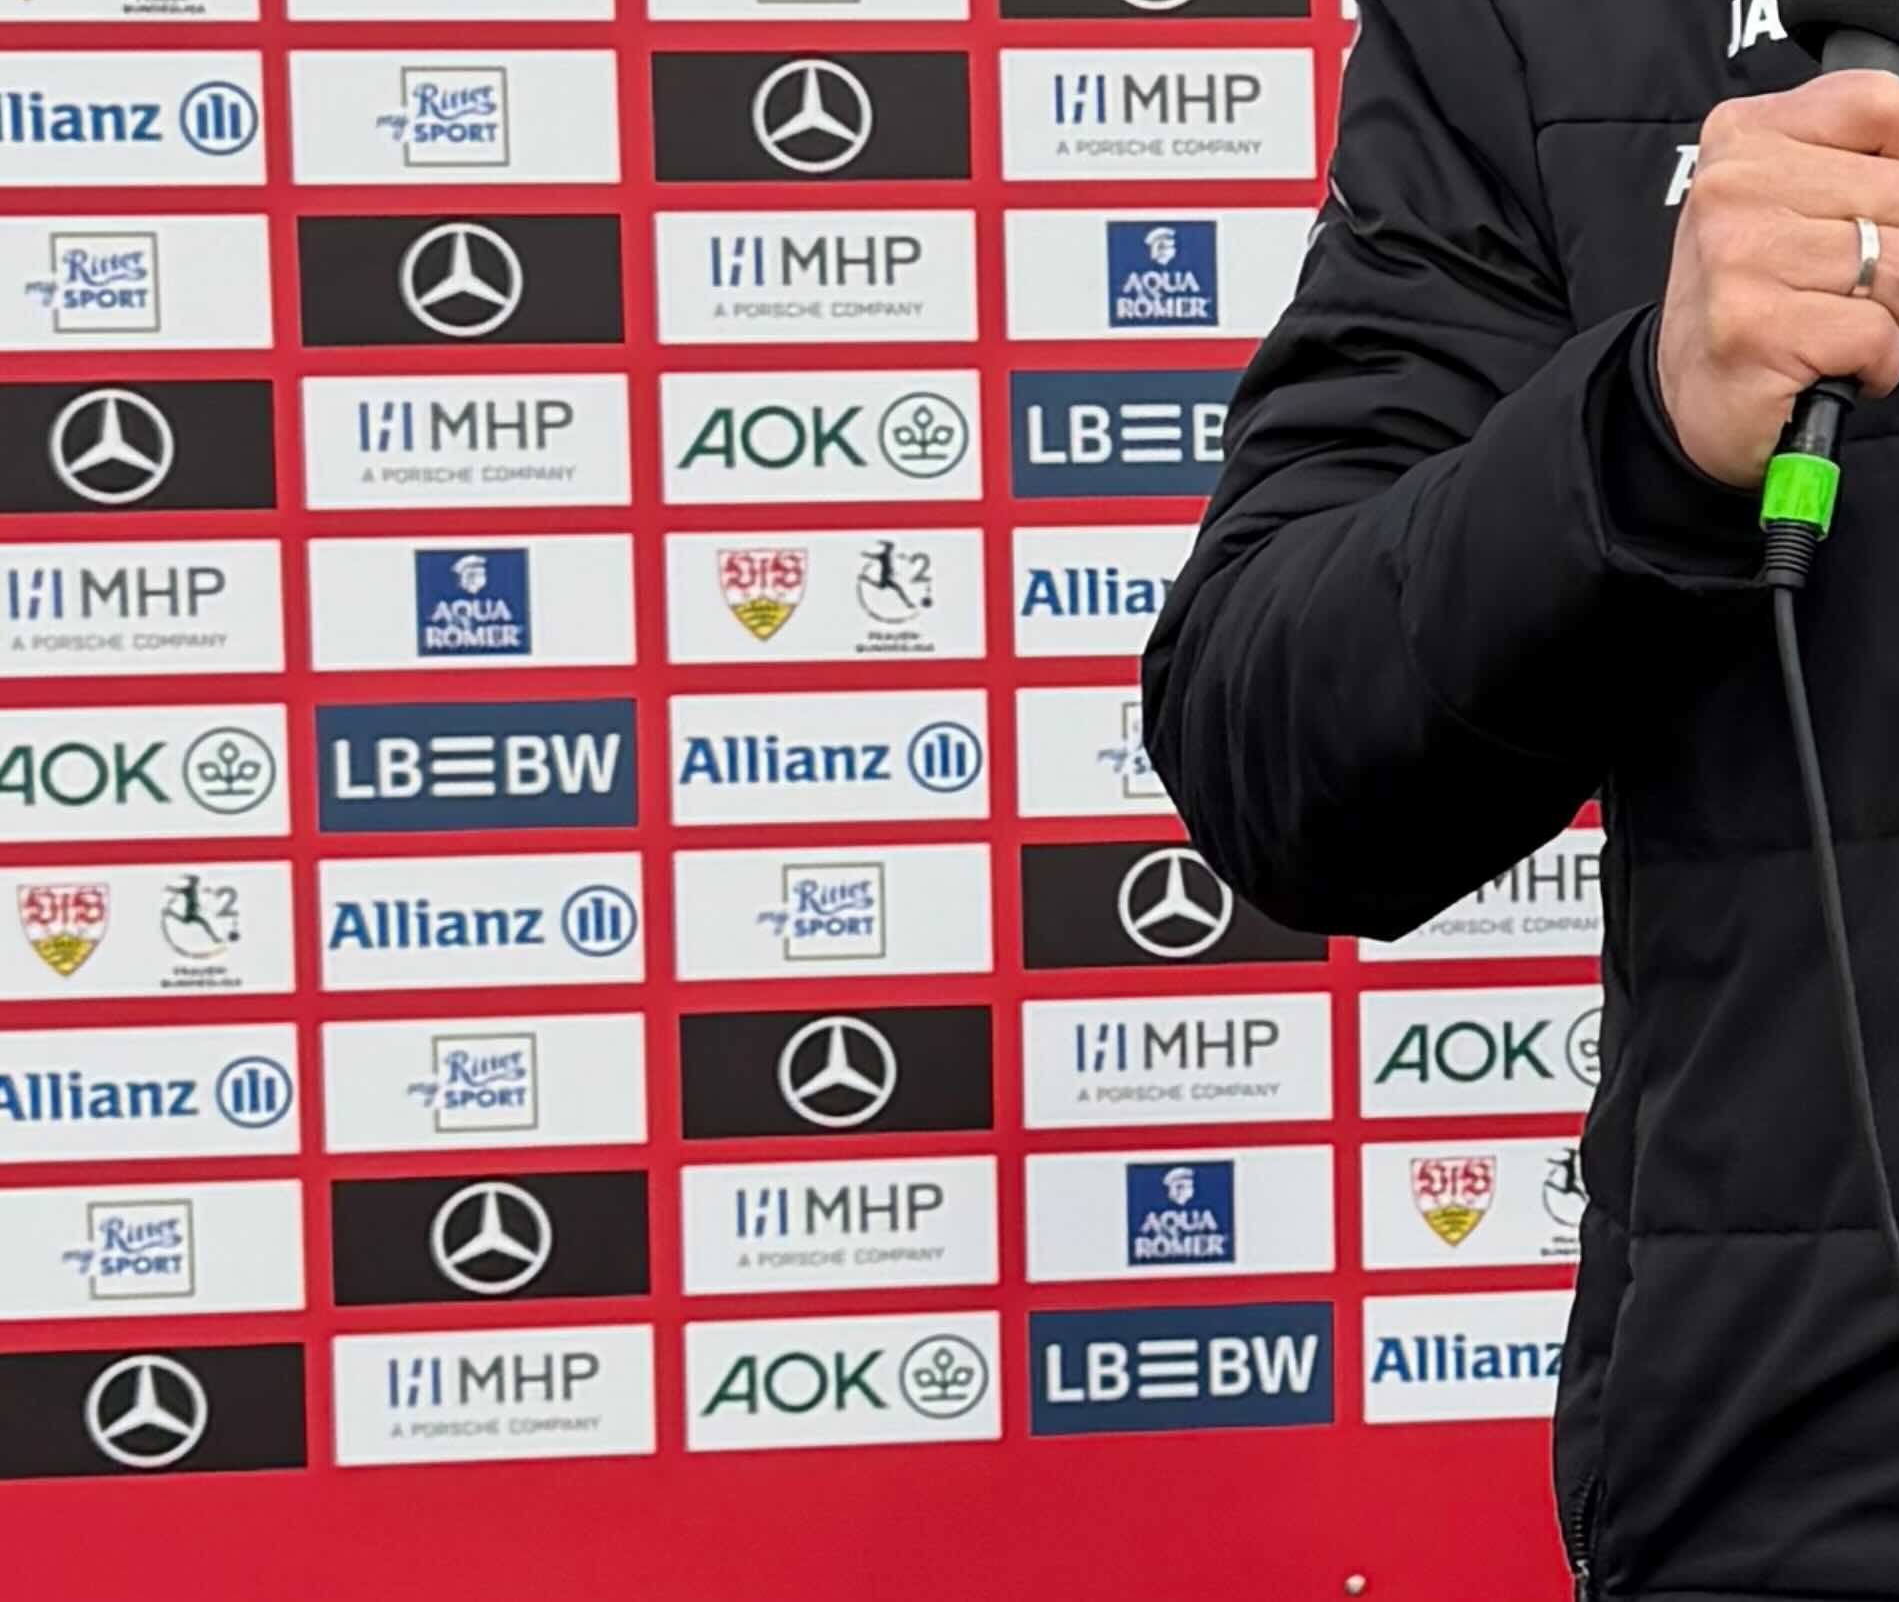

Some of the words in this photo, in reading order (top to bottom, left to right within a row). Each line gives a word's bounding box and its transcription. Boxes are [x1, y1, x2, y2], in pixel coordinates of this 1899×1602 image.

[1123, 74, 1260, 123] MHP
[414, 120, 498, 143] SPORT
[1076, 139, 1164, 156] PORSCHE
[1172, 139, 1262, 156] COMPANY
[782, 236, 921, 286] MHP
[1123, 271, 1200, 294] AQUA
[64, 289, 147, 308] SPORT
[431, 400, 573, 451] MHP
[678, 406, 866, 469] AOK
[80, 567, 225, 618] MHP
[432, 600, 511, 625] AQUA
[680, 735, 890, 784] Allianz
[329, 899, 544, 950] Allianz
[795, 914, 874, 937] SPORT
[1144, 1020, 1278, 1070] MHP
[1375, 1020, 1554, 1084] AOK
[445, 1086, 526, 1108] SPORT
[806, 1183, 943, 1234] MHP
[1142, 1211, 1217, 1236] AQUA
[100, 1254, 182, 1275] SPORT
[459, 1353, 599, 1404] MHP
[702, 1350, 886, 1416] AOK
